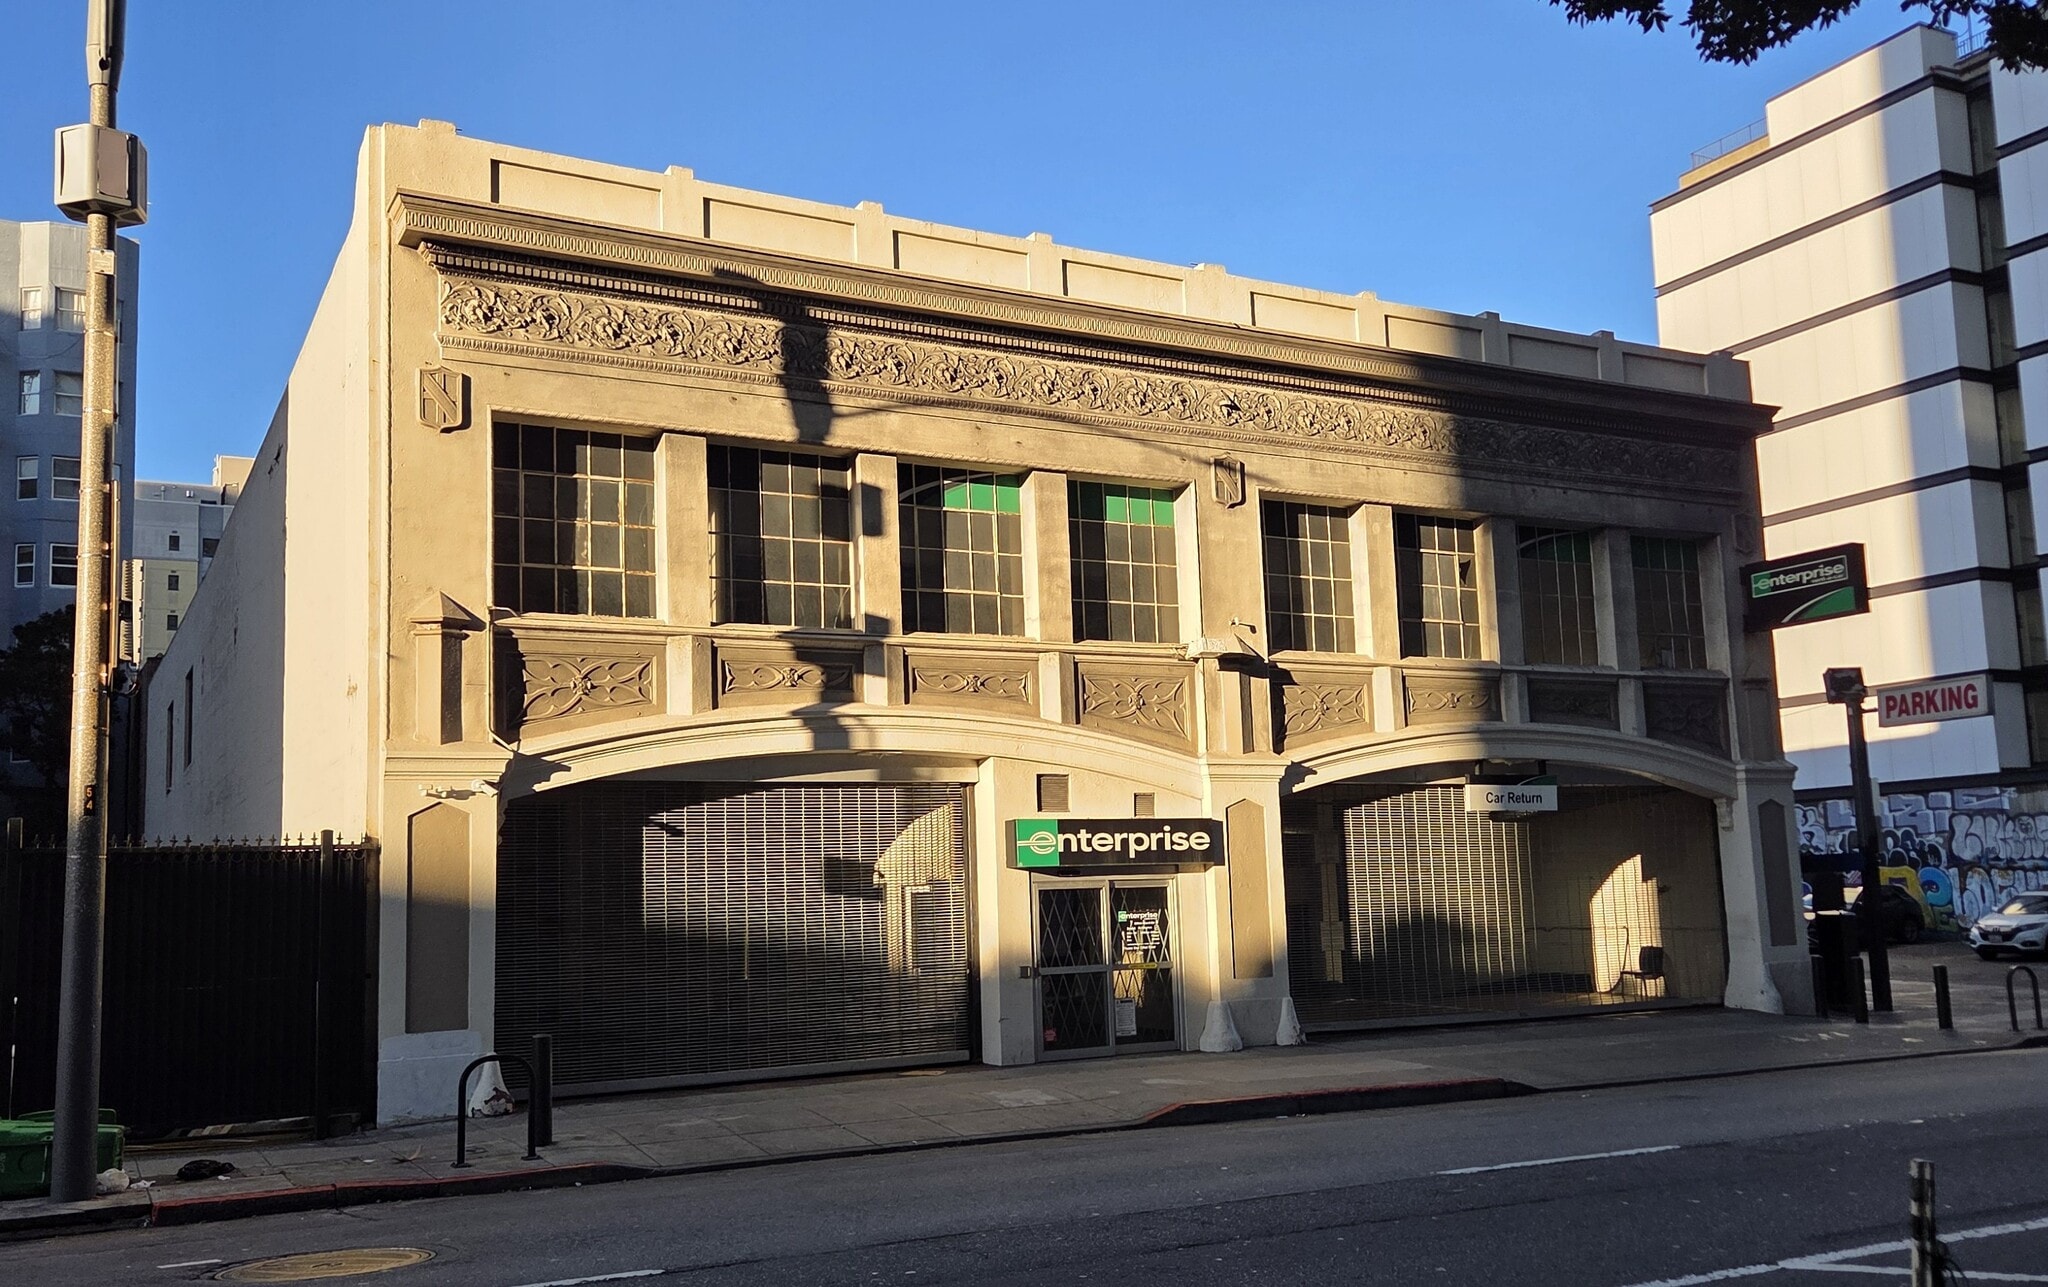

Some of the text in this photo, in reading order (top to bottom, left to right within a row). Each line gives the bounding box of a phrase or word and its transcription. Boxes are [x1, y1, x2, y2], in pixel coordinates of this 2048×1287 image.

[1756, 564, 1844, 590] enterprise
[1885, 683, 1978, 719] PARKING
[1486, 792, 1543, 804] Car Return
[1018, 826, 1211, 859] enterprise
